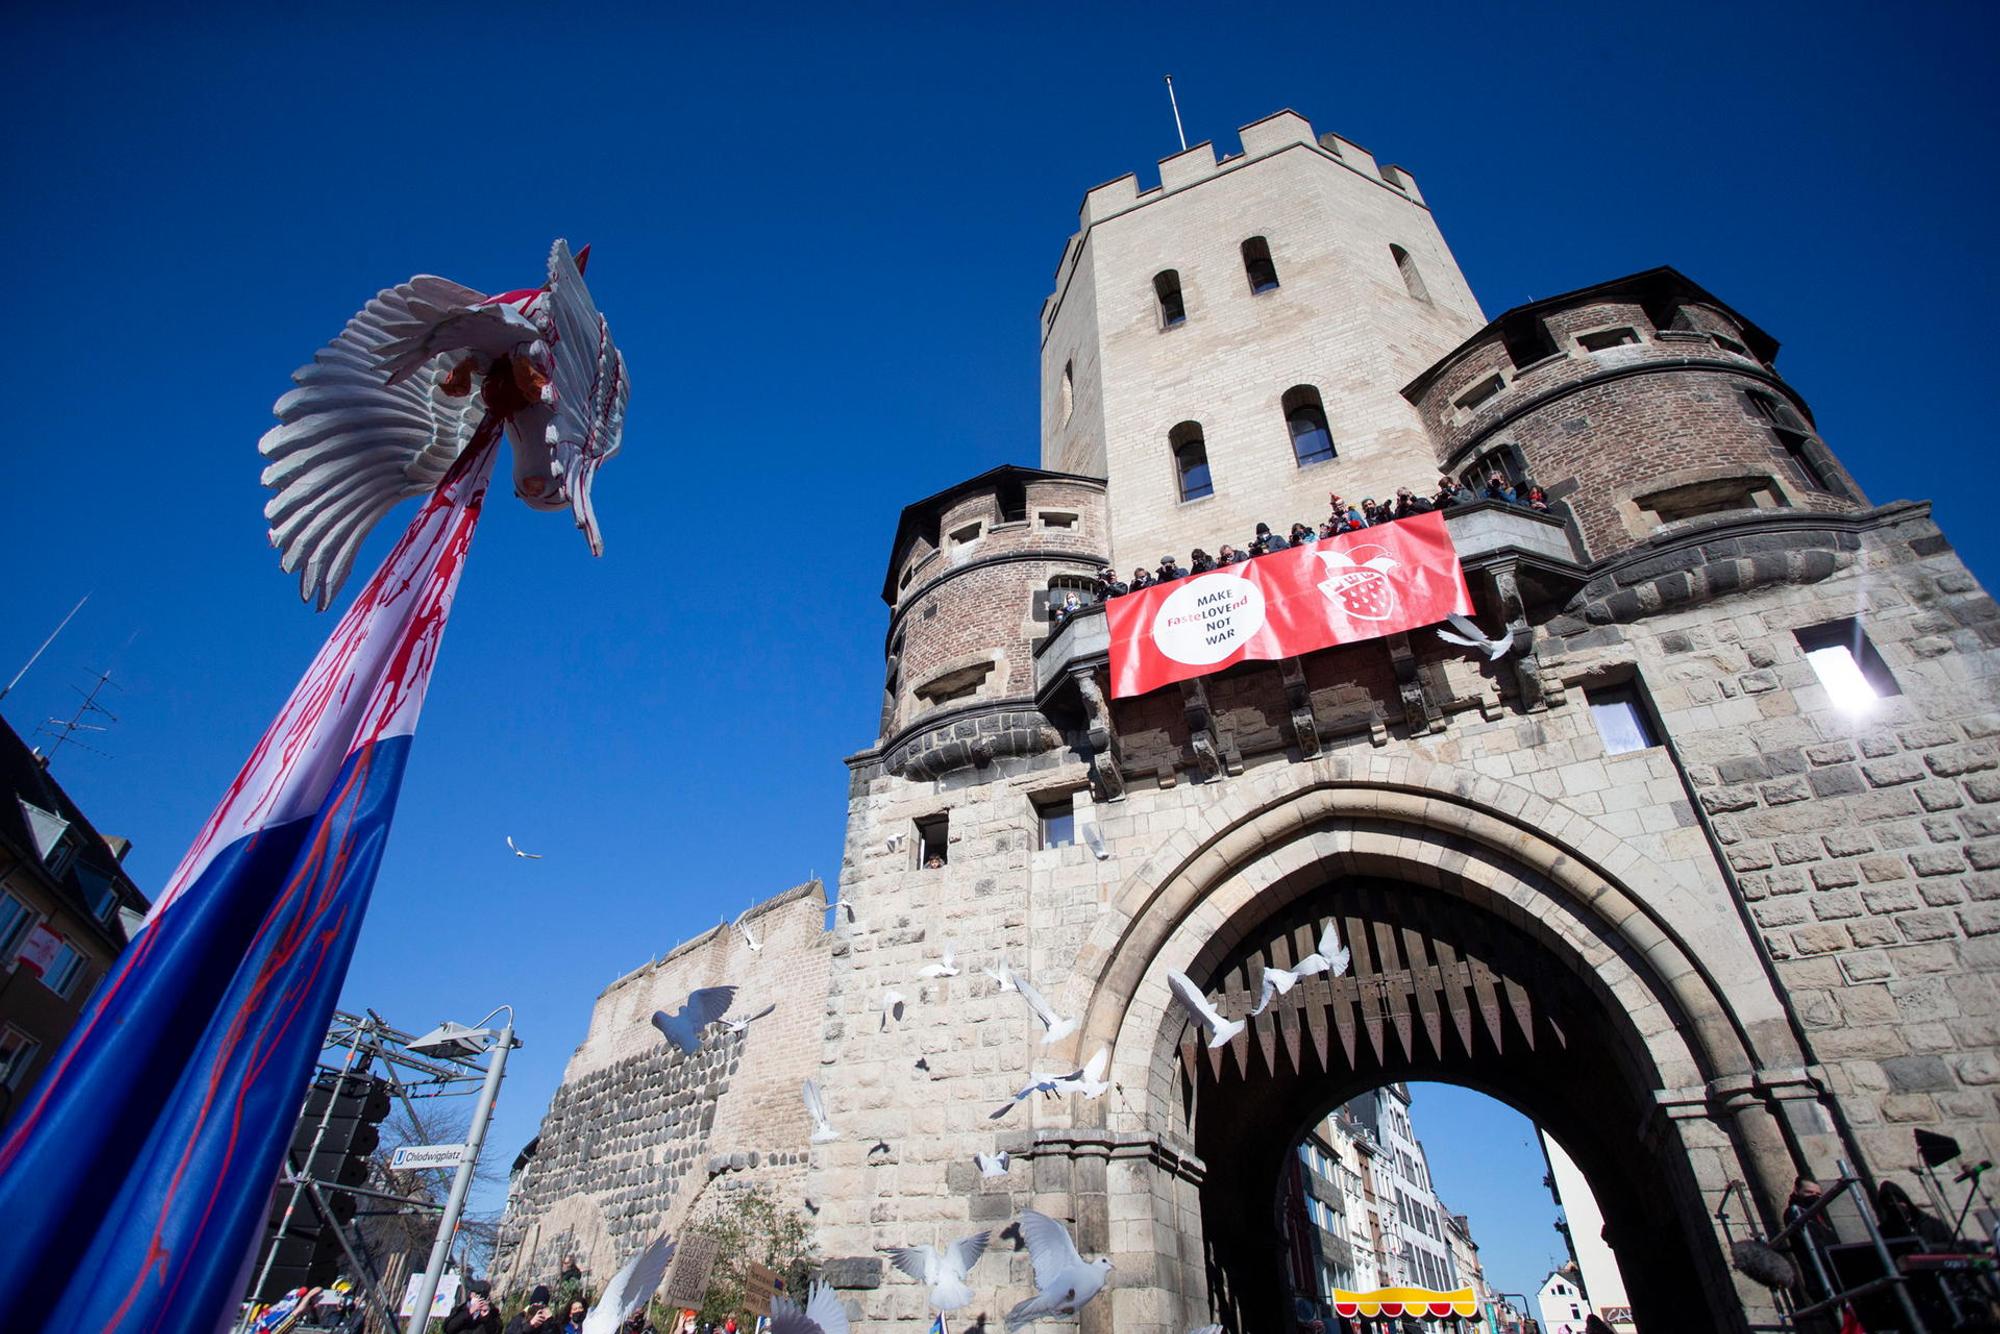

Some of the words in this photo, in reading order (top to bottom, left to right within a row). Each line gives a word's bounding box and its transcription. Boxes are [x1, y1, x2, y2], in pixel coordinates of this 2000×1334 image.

[1197, 589, 1233, 607] MAKE
[1206, 617, 1231, 632] NOT
[1205, 628, 1235, 646] WAR
[406, 1151, 461, 1163] Chlodwigplatz
